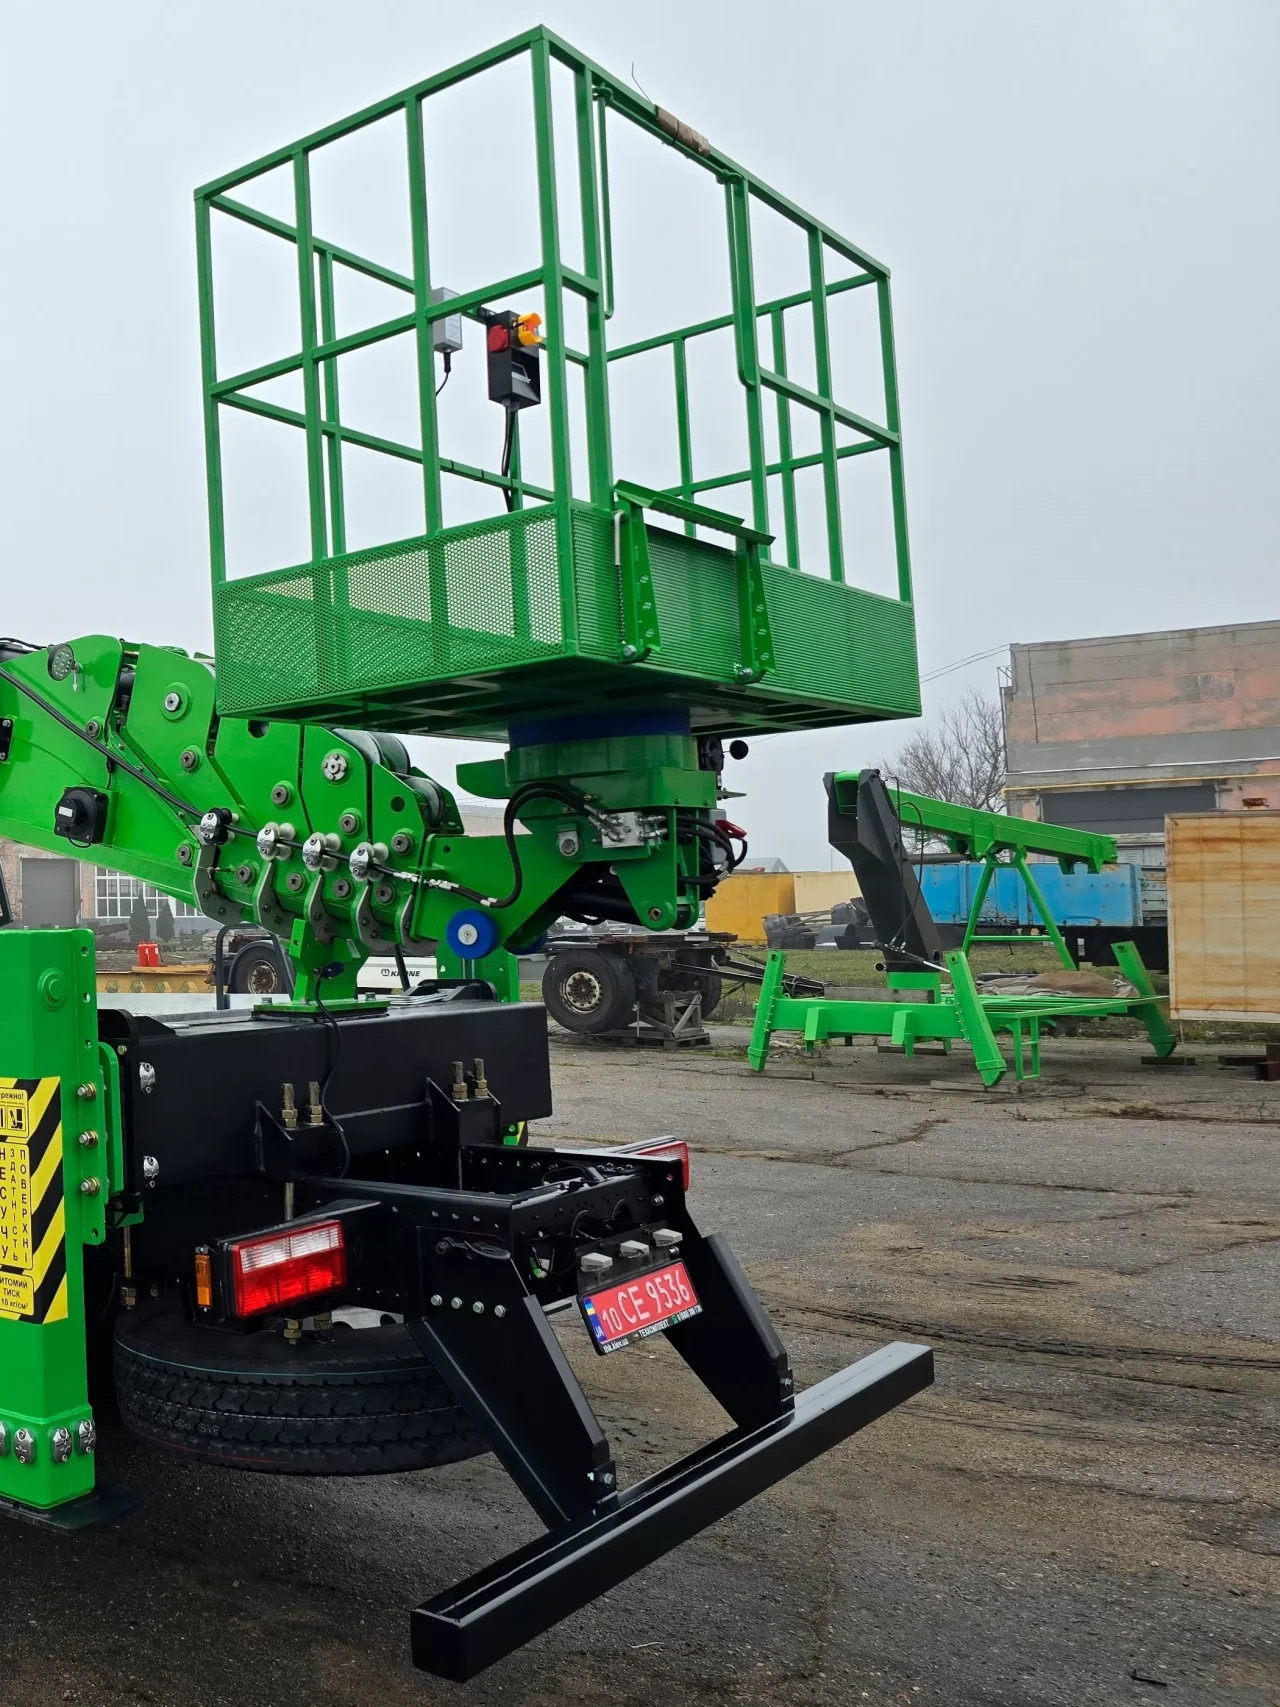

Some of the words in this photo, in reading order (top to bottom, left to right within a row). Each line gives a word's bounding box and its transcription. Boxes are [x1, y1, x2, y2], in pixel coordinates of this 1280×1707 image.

[10, 1148, 19, 1261] ЗДАТНІСТЬ
[20, 1149, 29, 1263] ПОВЕРХНІ
[2, 1287, 21, 1298] ТИСК
[602, 1306, 623, 1334] 10
[617, 1285, 651, 1324] CE
[645, 1269, 691, 1314] 9536
[594, 1325, 605, 1339] UA
